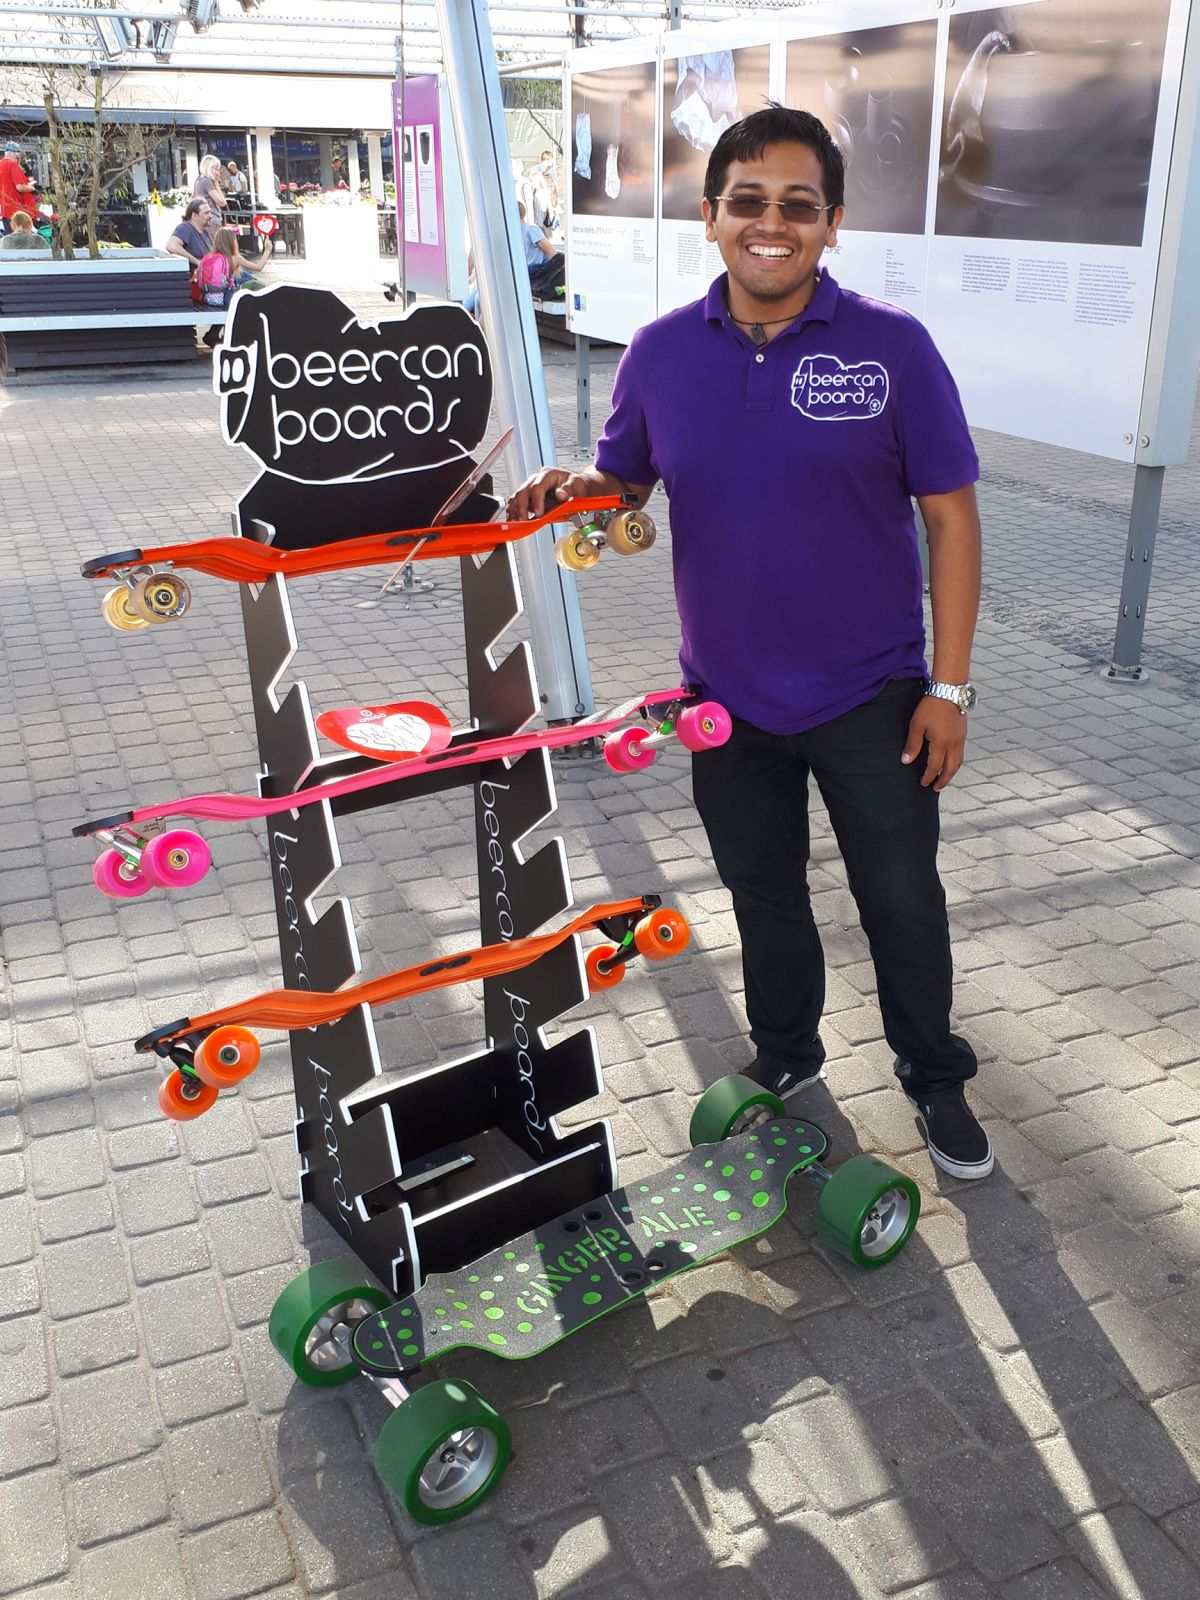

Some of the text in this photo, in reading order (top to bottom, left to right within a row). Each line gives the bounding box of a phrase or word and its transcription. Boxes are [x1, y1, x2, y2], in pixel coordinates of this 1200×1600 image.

[259, 312, 483, 389] beercan
[809, 362, 885, 386] beercan
[271, 385, 461, 460] boards
[807, 387, 874, 408] boards
[480, 780, 546, 1155] beerca boards
[273, 830, 353, 1236] beerca boards
[516, 1206, 714, 1314] GINGER ALE
